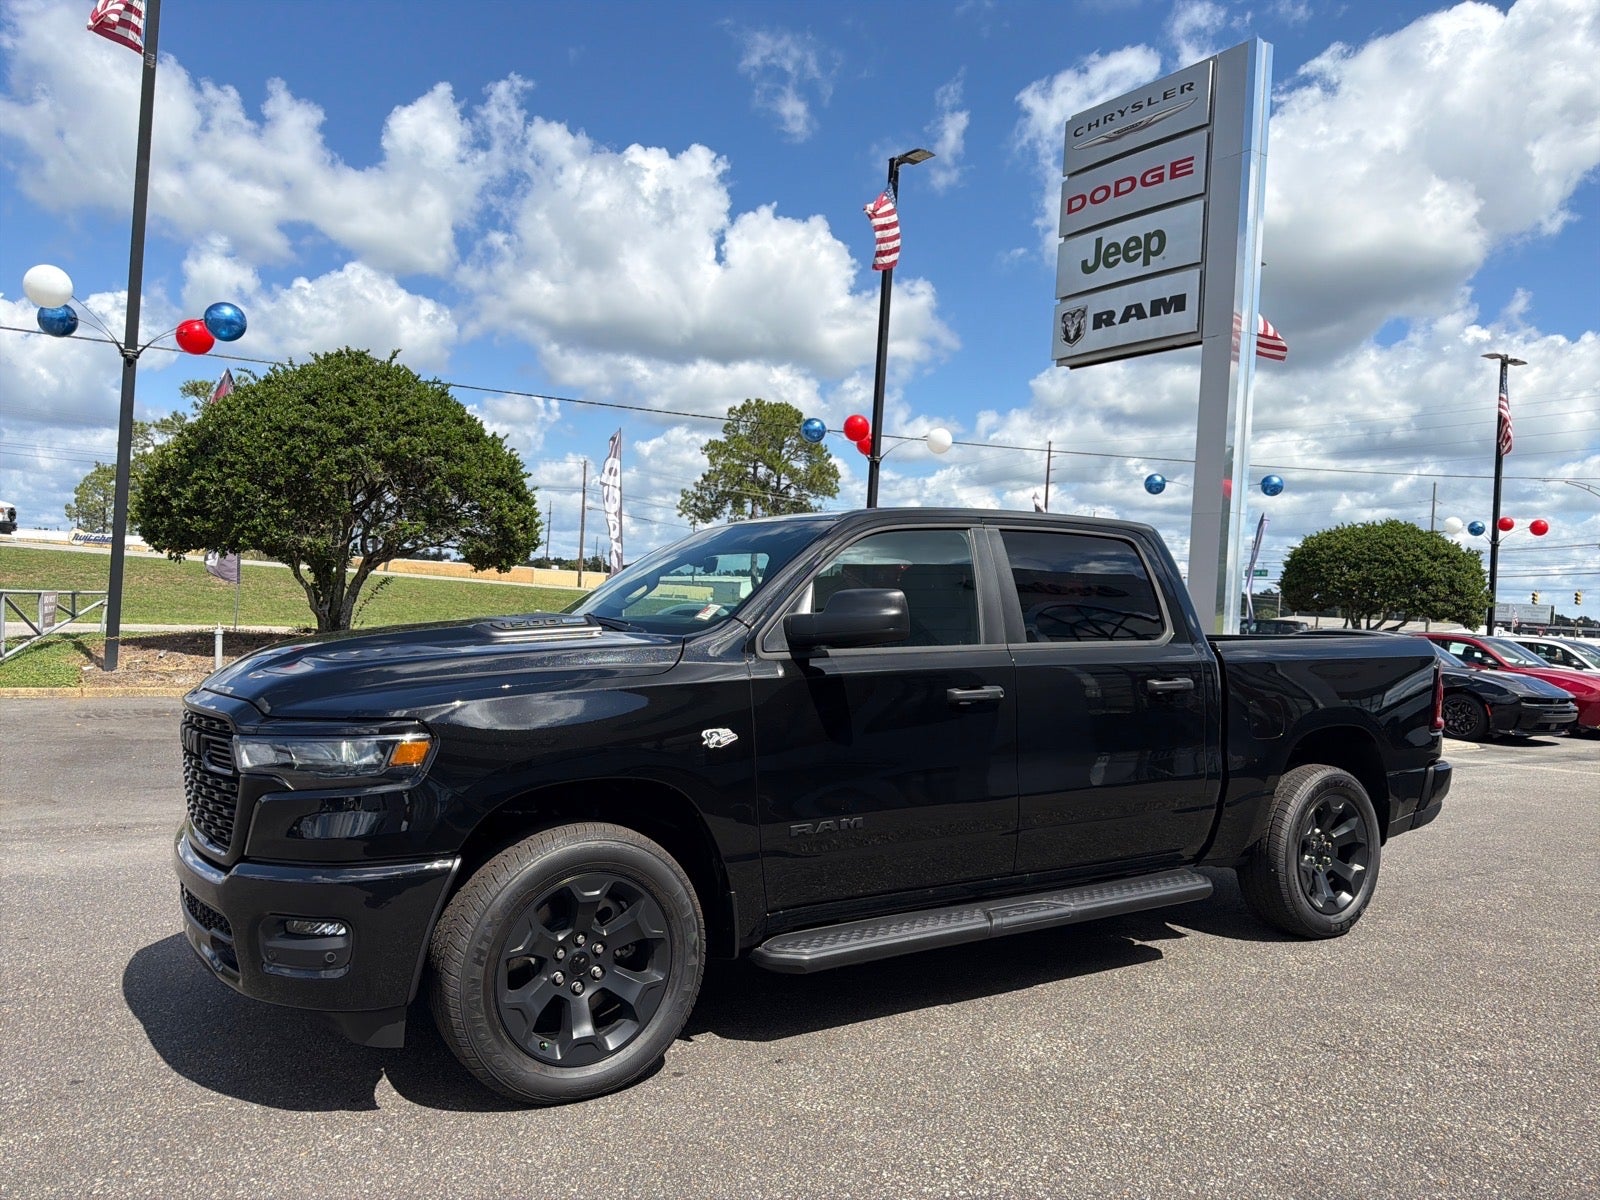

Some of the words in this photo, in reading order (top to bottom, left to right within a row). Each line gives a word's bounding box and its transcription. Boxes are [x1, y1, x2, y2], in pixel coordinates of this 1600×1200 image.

[1073, 81, 1195, 138] CHRYSLER
[1066, 155, 1195, 215] DODGE
[1080, 228, 1167, 275] Jeep
[1092, 293, 1187, 331] RAM
[502, 618, 557, 629] 1500
[789, 816, 864, 837] RAM
